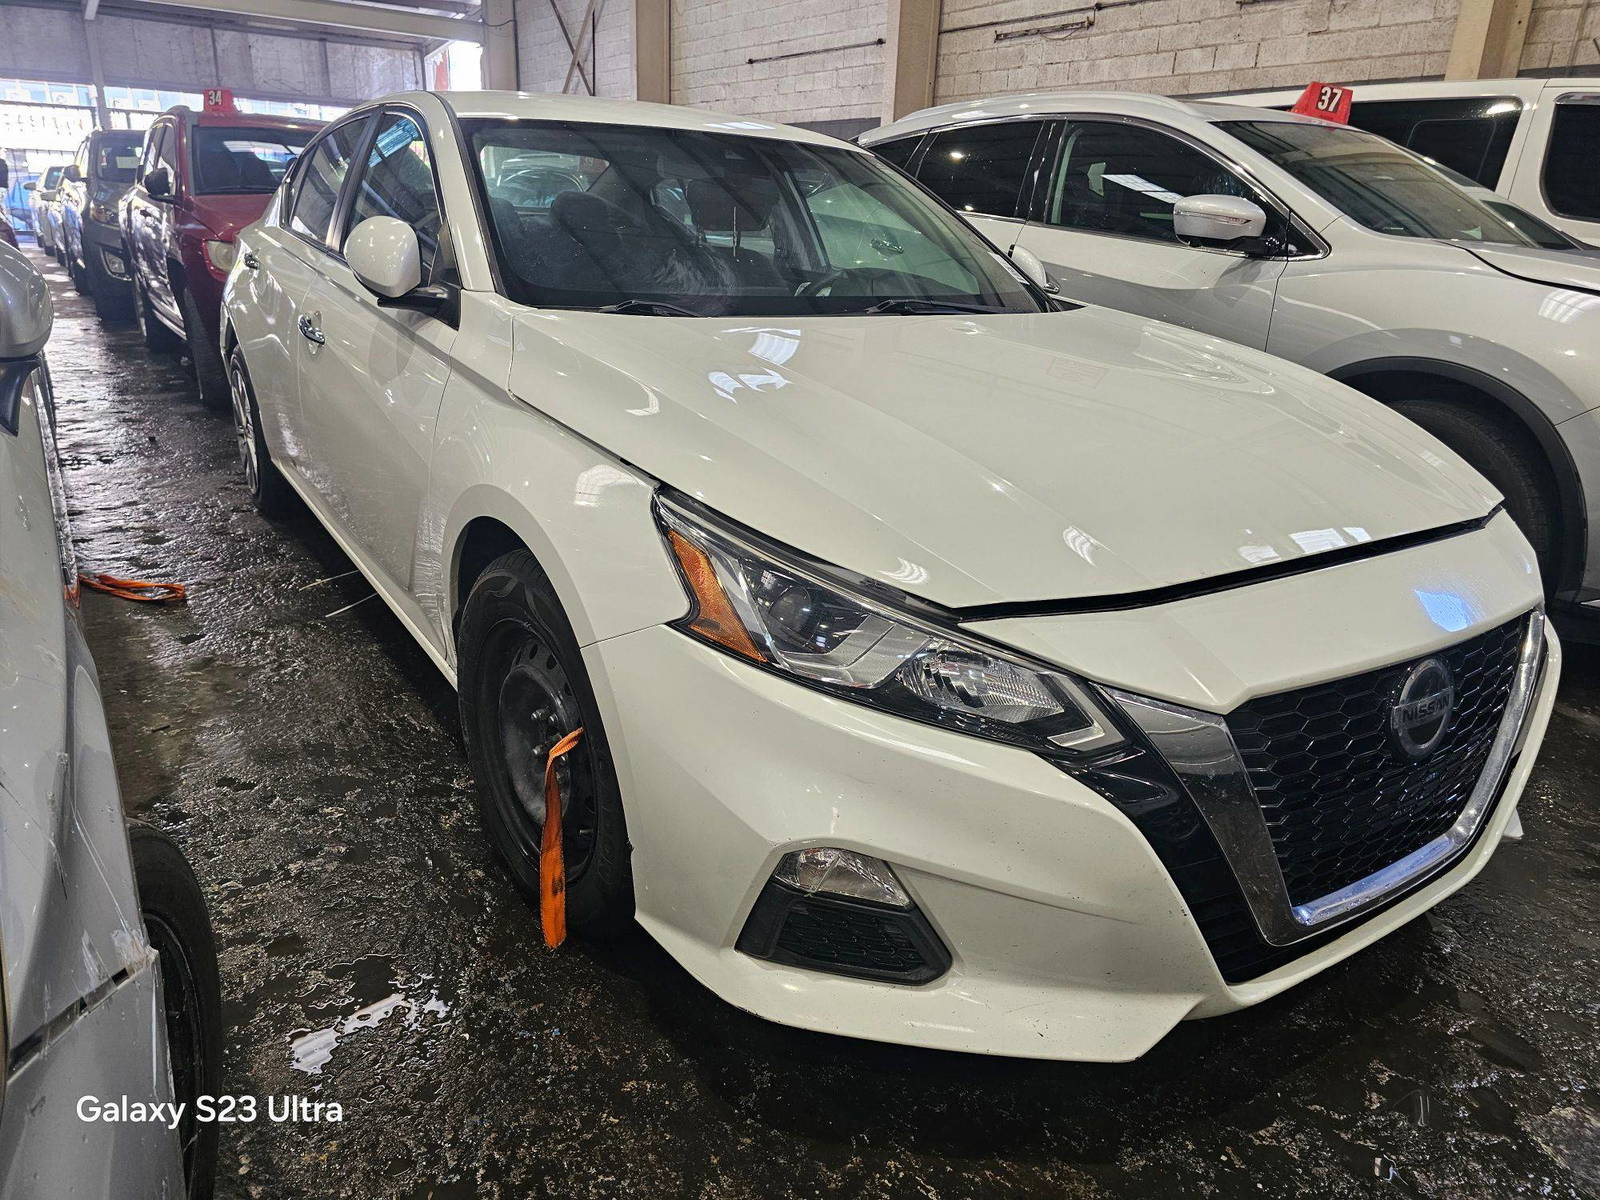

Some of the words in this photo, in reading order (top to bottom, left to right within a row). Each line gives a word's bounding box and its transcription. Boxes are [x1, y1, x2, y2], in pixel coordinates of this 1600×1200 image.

[208, 90, 222, 105] 34
[1317, 86, 1343, 112] 37
[1402, 694, 1450, 723] NISSAN
